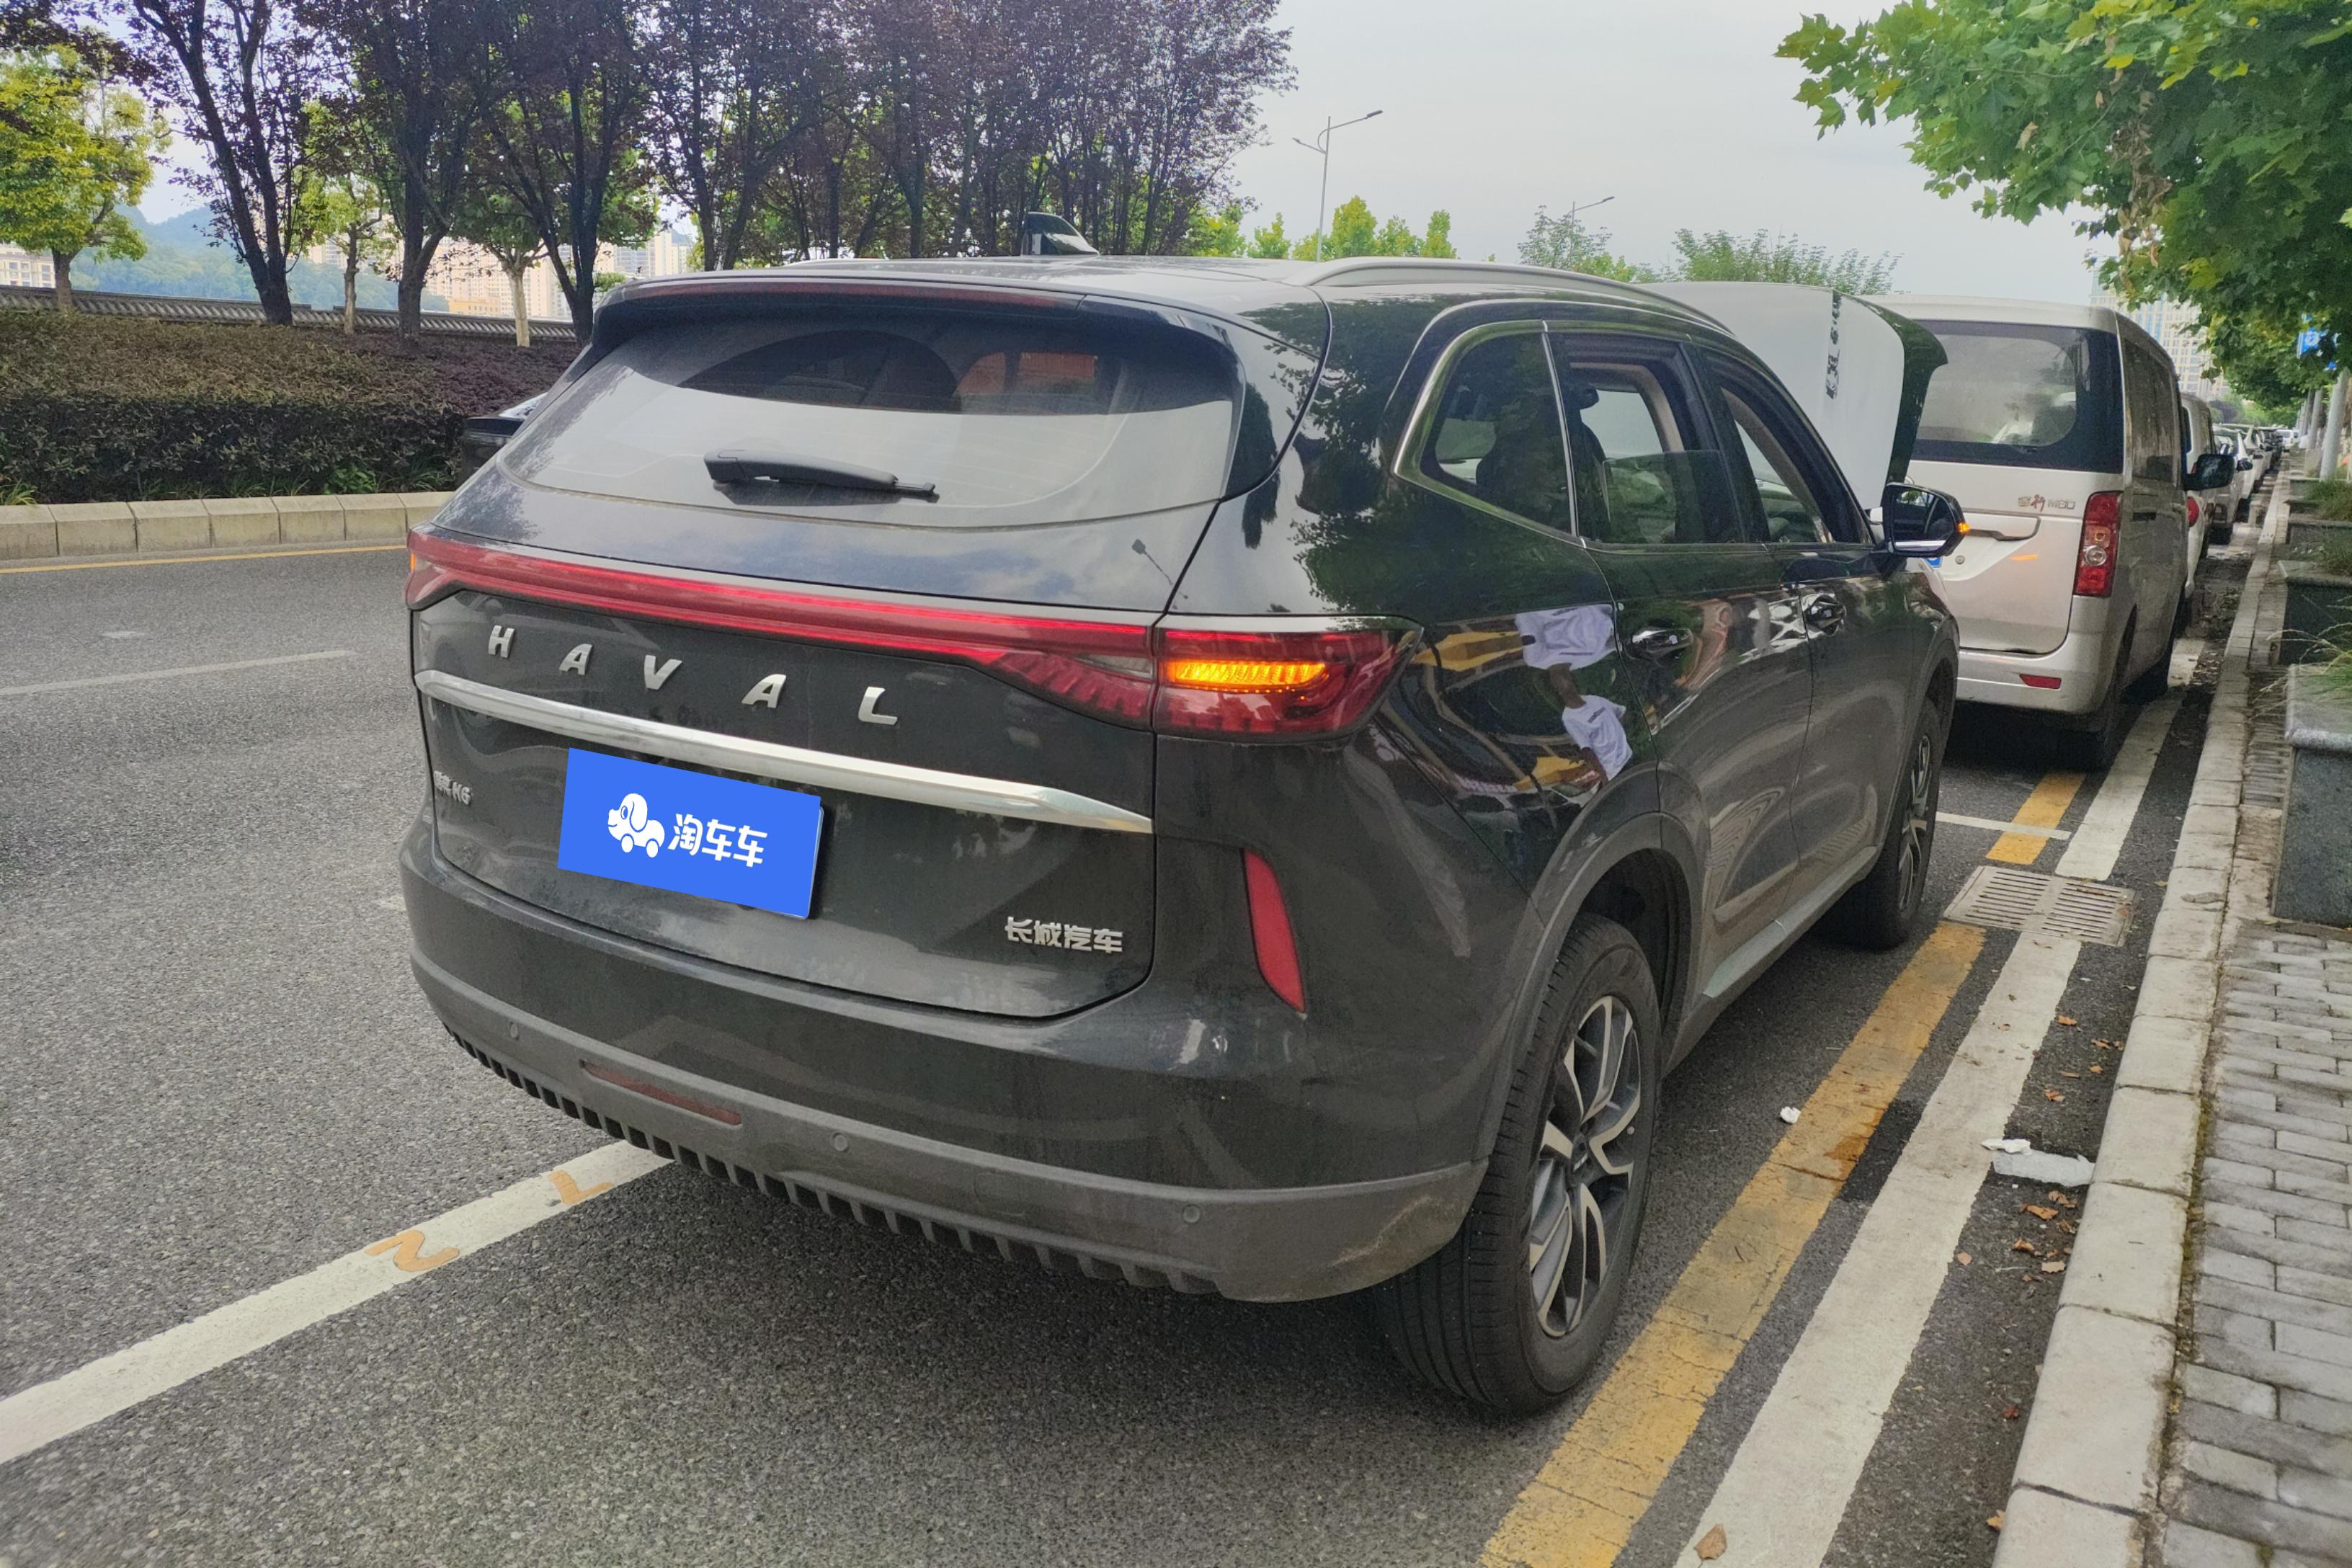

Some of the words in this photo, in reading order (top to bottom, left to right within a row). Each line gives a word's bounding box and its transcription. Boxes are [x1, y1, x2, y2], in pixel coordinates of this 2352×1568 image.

[488, 625, 899, 726] HAVAL
[1004, 916, 1123, 954] 长城汽车
